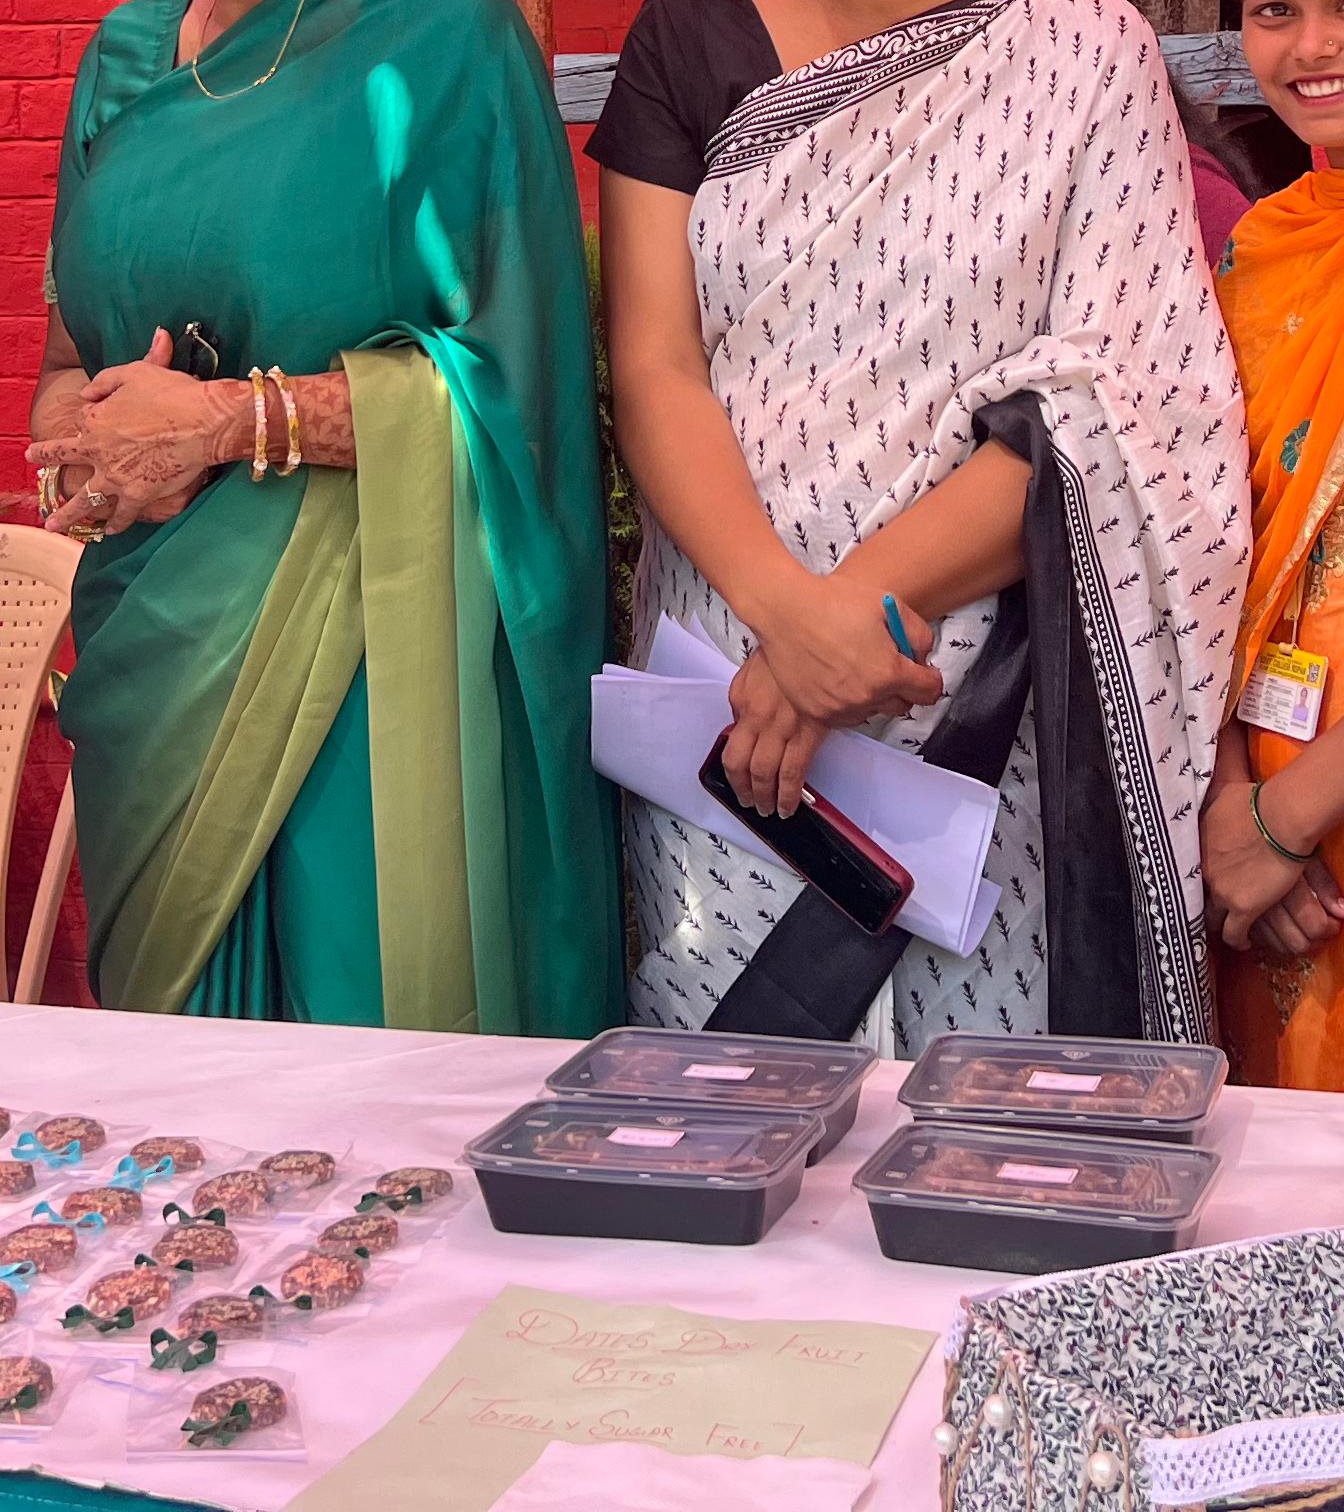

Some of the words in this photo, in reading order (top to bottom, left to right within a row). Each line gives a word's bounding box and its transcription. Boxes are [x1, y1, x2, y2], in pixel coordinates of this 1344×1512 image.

[506, 1308, 656, 1352] DATES
[776, 1333, 870, 1364] FRUIT
[571, 1356, 677, 1387] BITES
[588, 1409, 674, 1442] SUGAR
